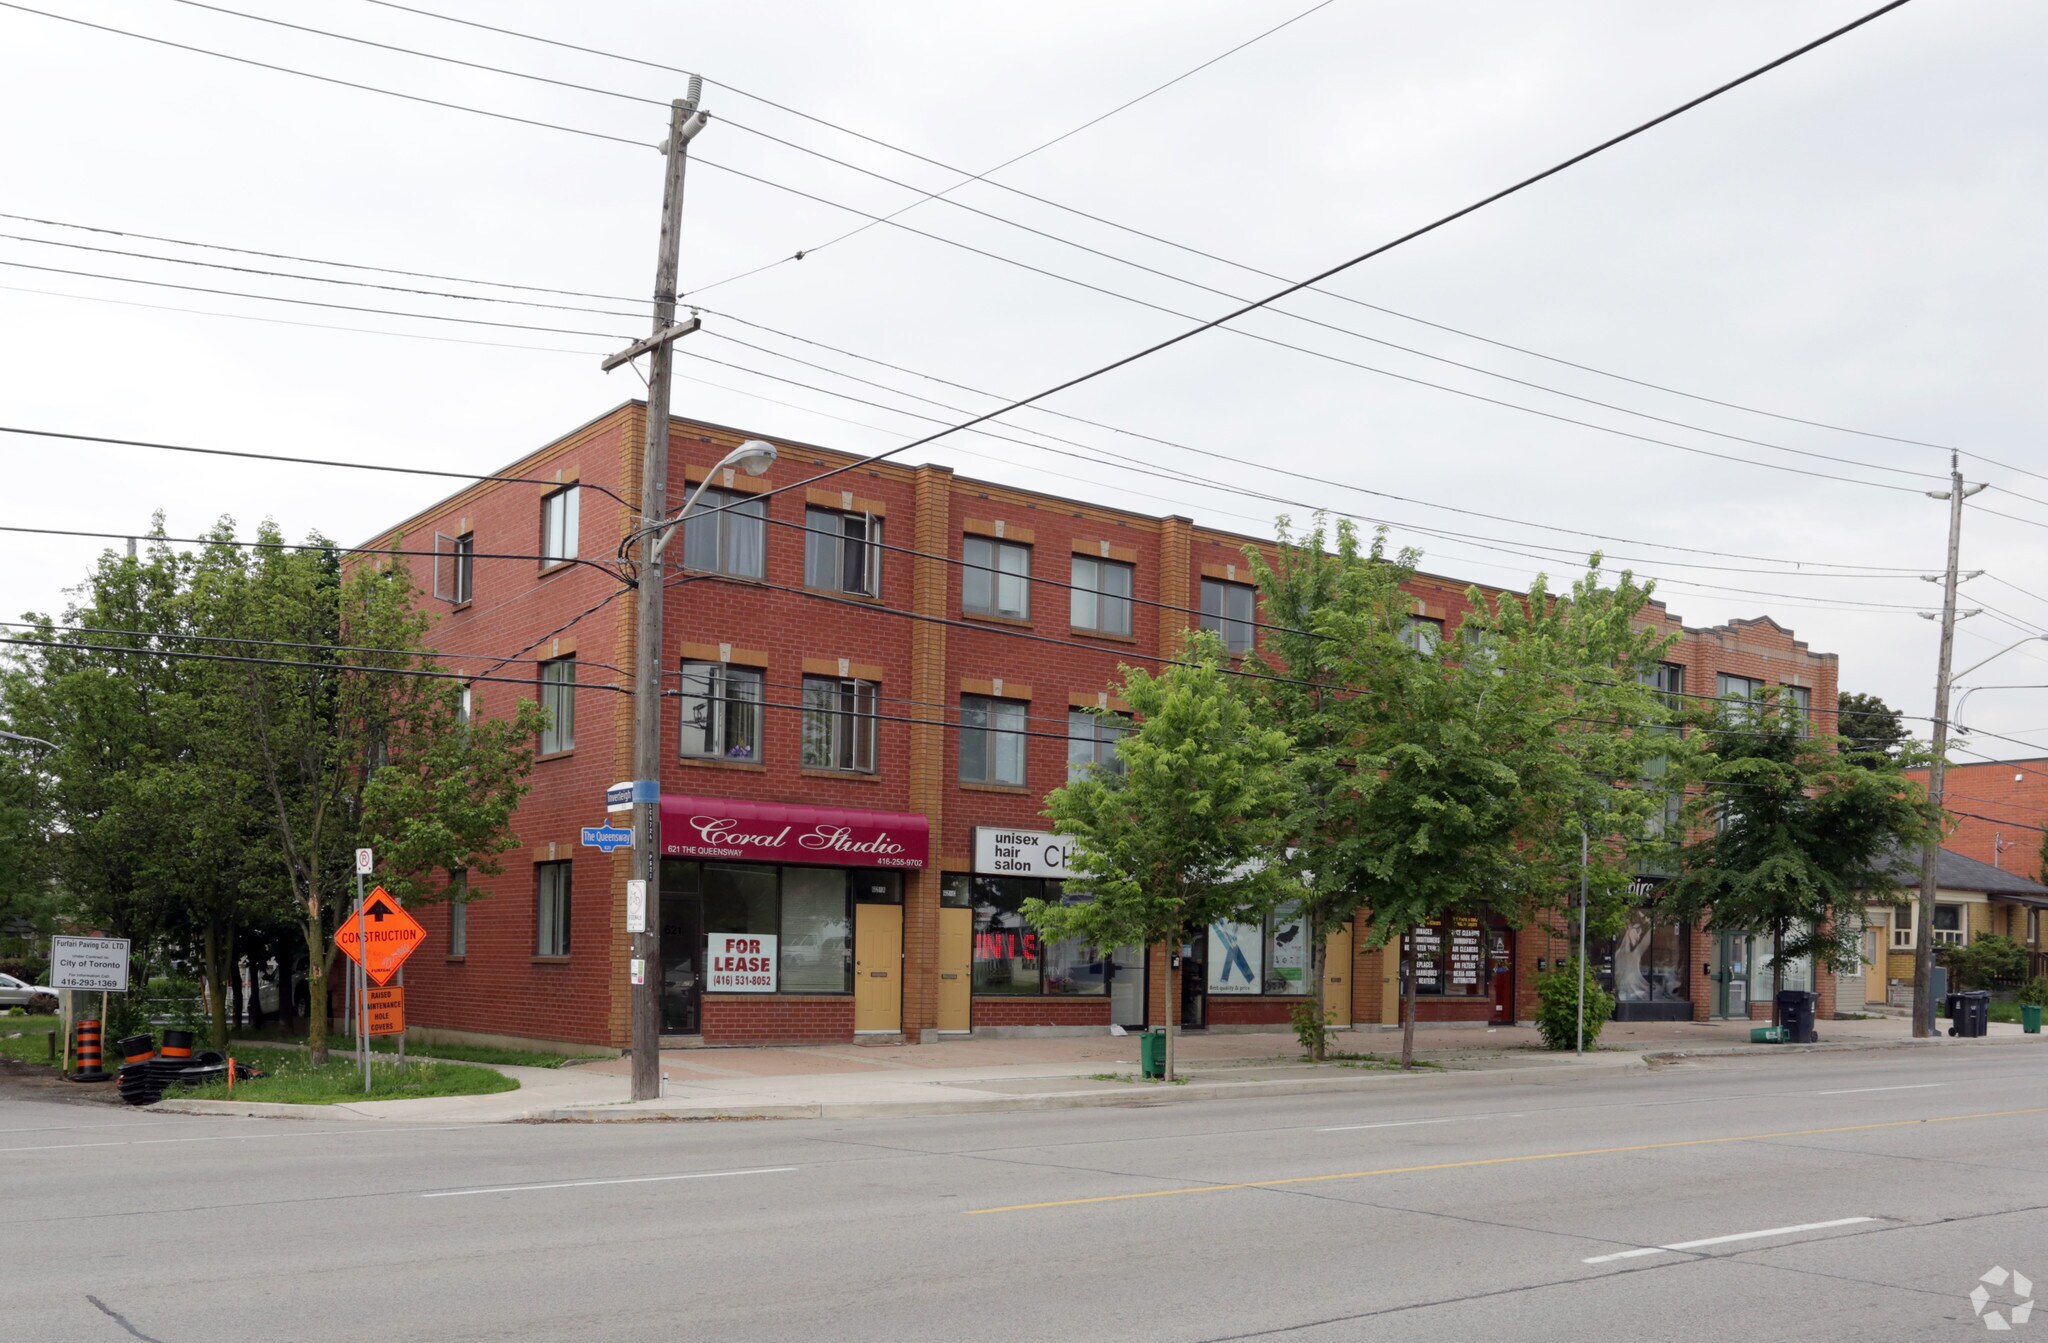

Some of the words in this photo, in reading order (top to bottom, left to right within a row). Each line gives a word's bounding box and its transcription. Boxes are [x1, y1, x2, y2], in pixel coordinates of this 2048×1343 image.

[607, 789, 632, 802] Inverleigh
[584, 831, 595, 842] The
[596, 831, 630, 845] Queensway
[690, 816, 791, 848] Coral
[798, 824, 905, 855] Studio
[995, 833, 1039, 845] unisex
[668, 845, 680, 853] 621
[682, 846, 696, 854] THE
[698, 847, 743, 856] QUEENSWAY
[995, 845, 1020, 858] hair
[877, 858, 923, 866] 416-255-9702
[994, 859, 1031, 871] salon
[664, 925, 682, 935] 621
[341, 929, 416, 944] CONSTRUCTION
[57, 940, 77, 948] Furfari
[79, 941, 99, 950] Paving
[725, 939, 761, 954] FOR
[60, 959, 76, 968] City
[78, 960, 87, 968] of
[89, 960, 120, 968] Toronto
[714, 957, 771, 972] LEASE
[61, 979, 117, 987] 416-293-1369
[713, 975, 733, 987] (416)
[735, 975, 771, 986] 531-8052
[371, 991, 392, 999] RAISED
[374, 1012, 389, 1020] HOLE
[370, 1023, 393, 1031] COVERS
